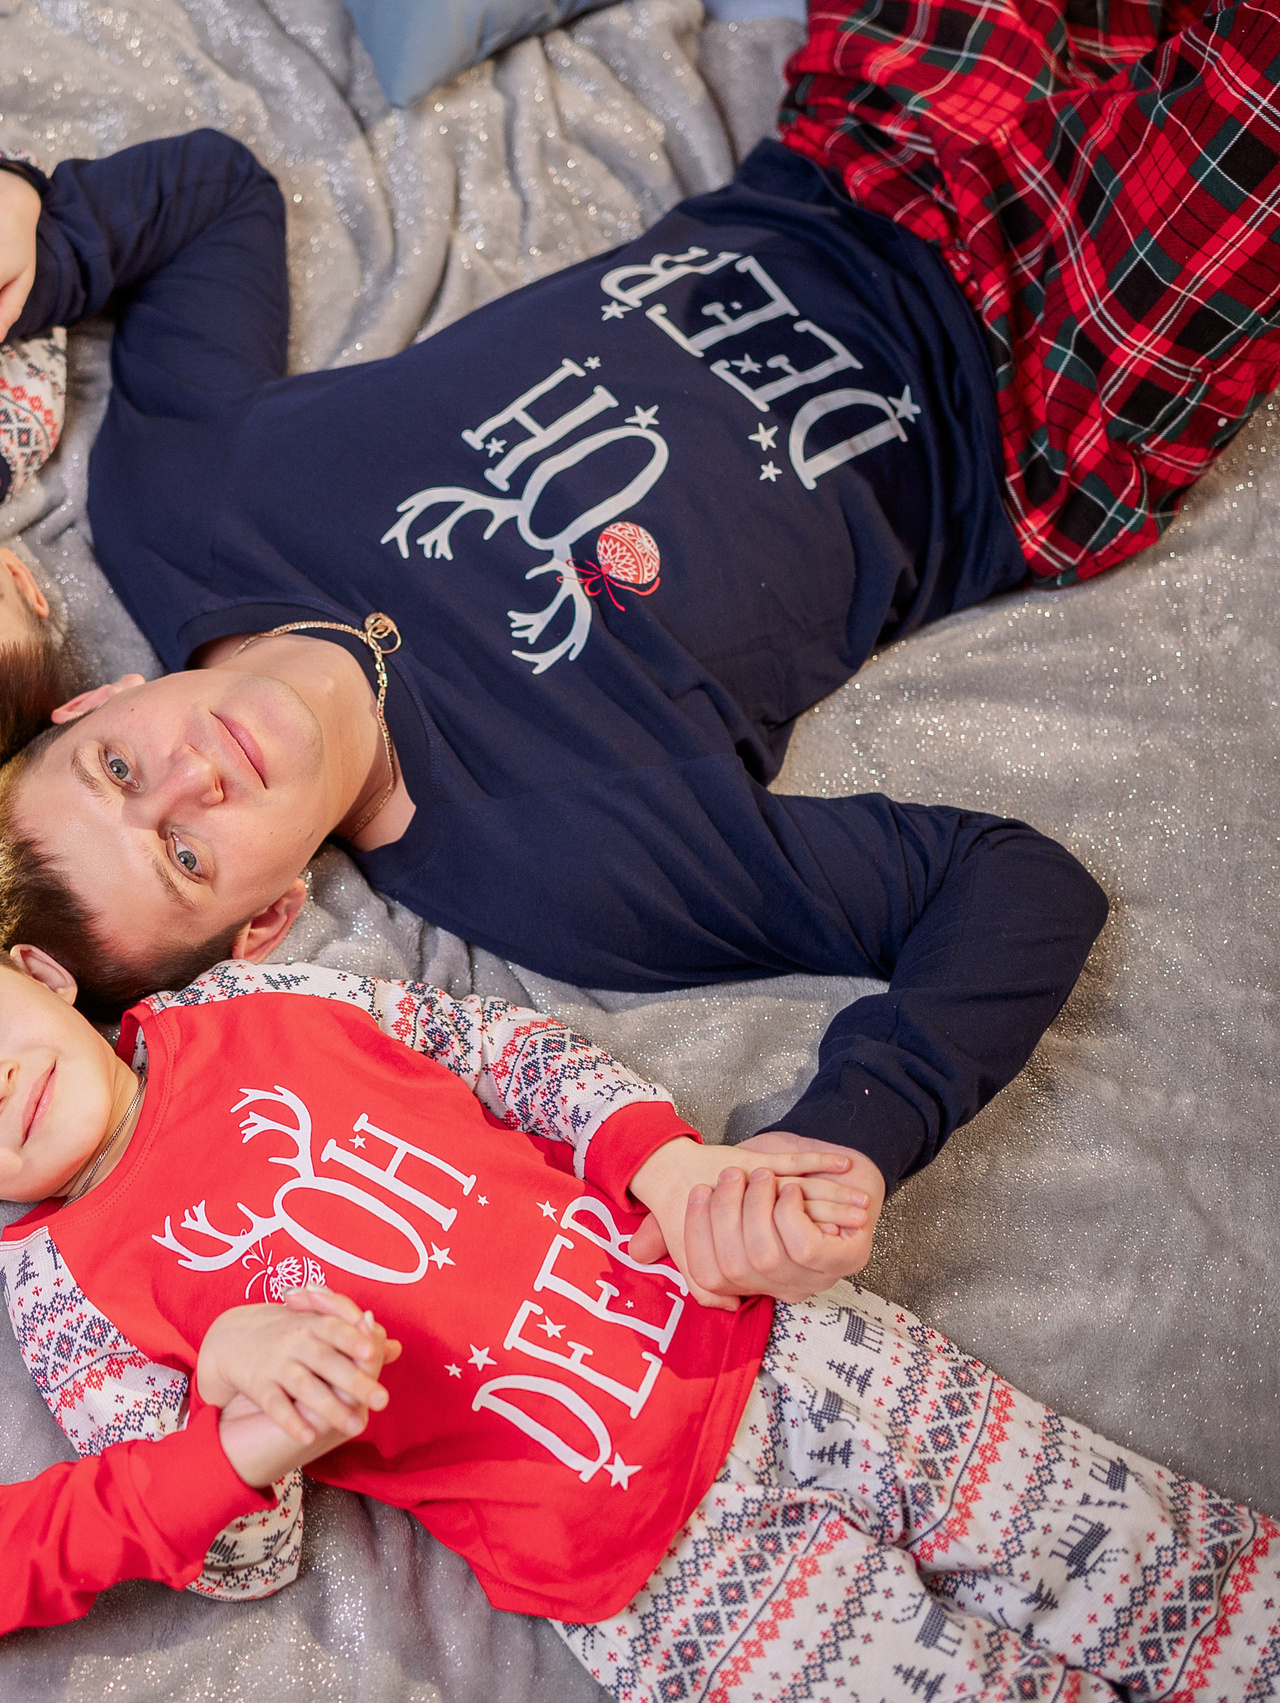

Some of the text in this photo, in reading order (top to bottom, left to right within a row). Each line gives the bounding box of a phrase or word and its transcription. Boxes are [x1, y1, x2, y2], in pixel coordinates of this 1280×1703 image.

[461, 358, 669, 550] OH
[600, 247, 908, 490] DEER
[273, 1113, 476, 1284] OH
